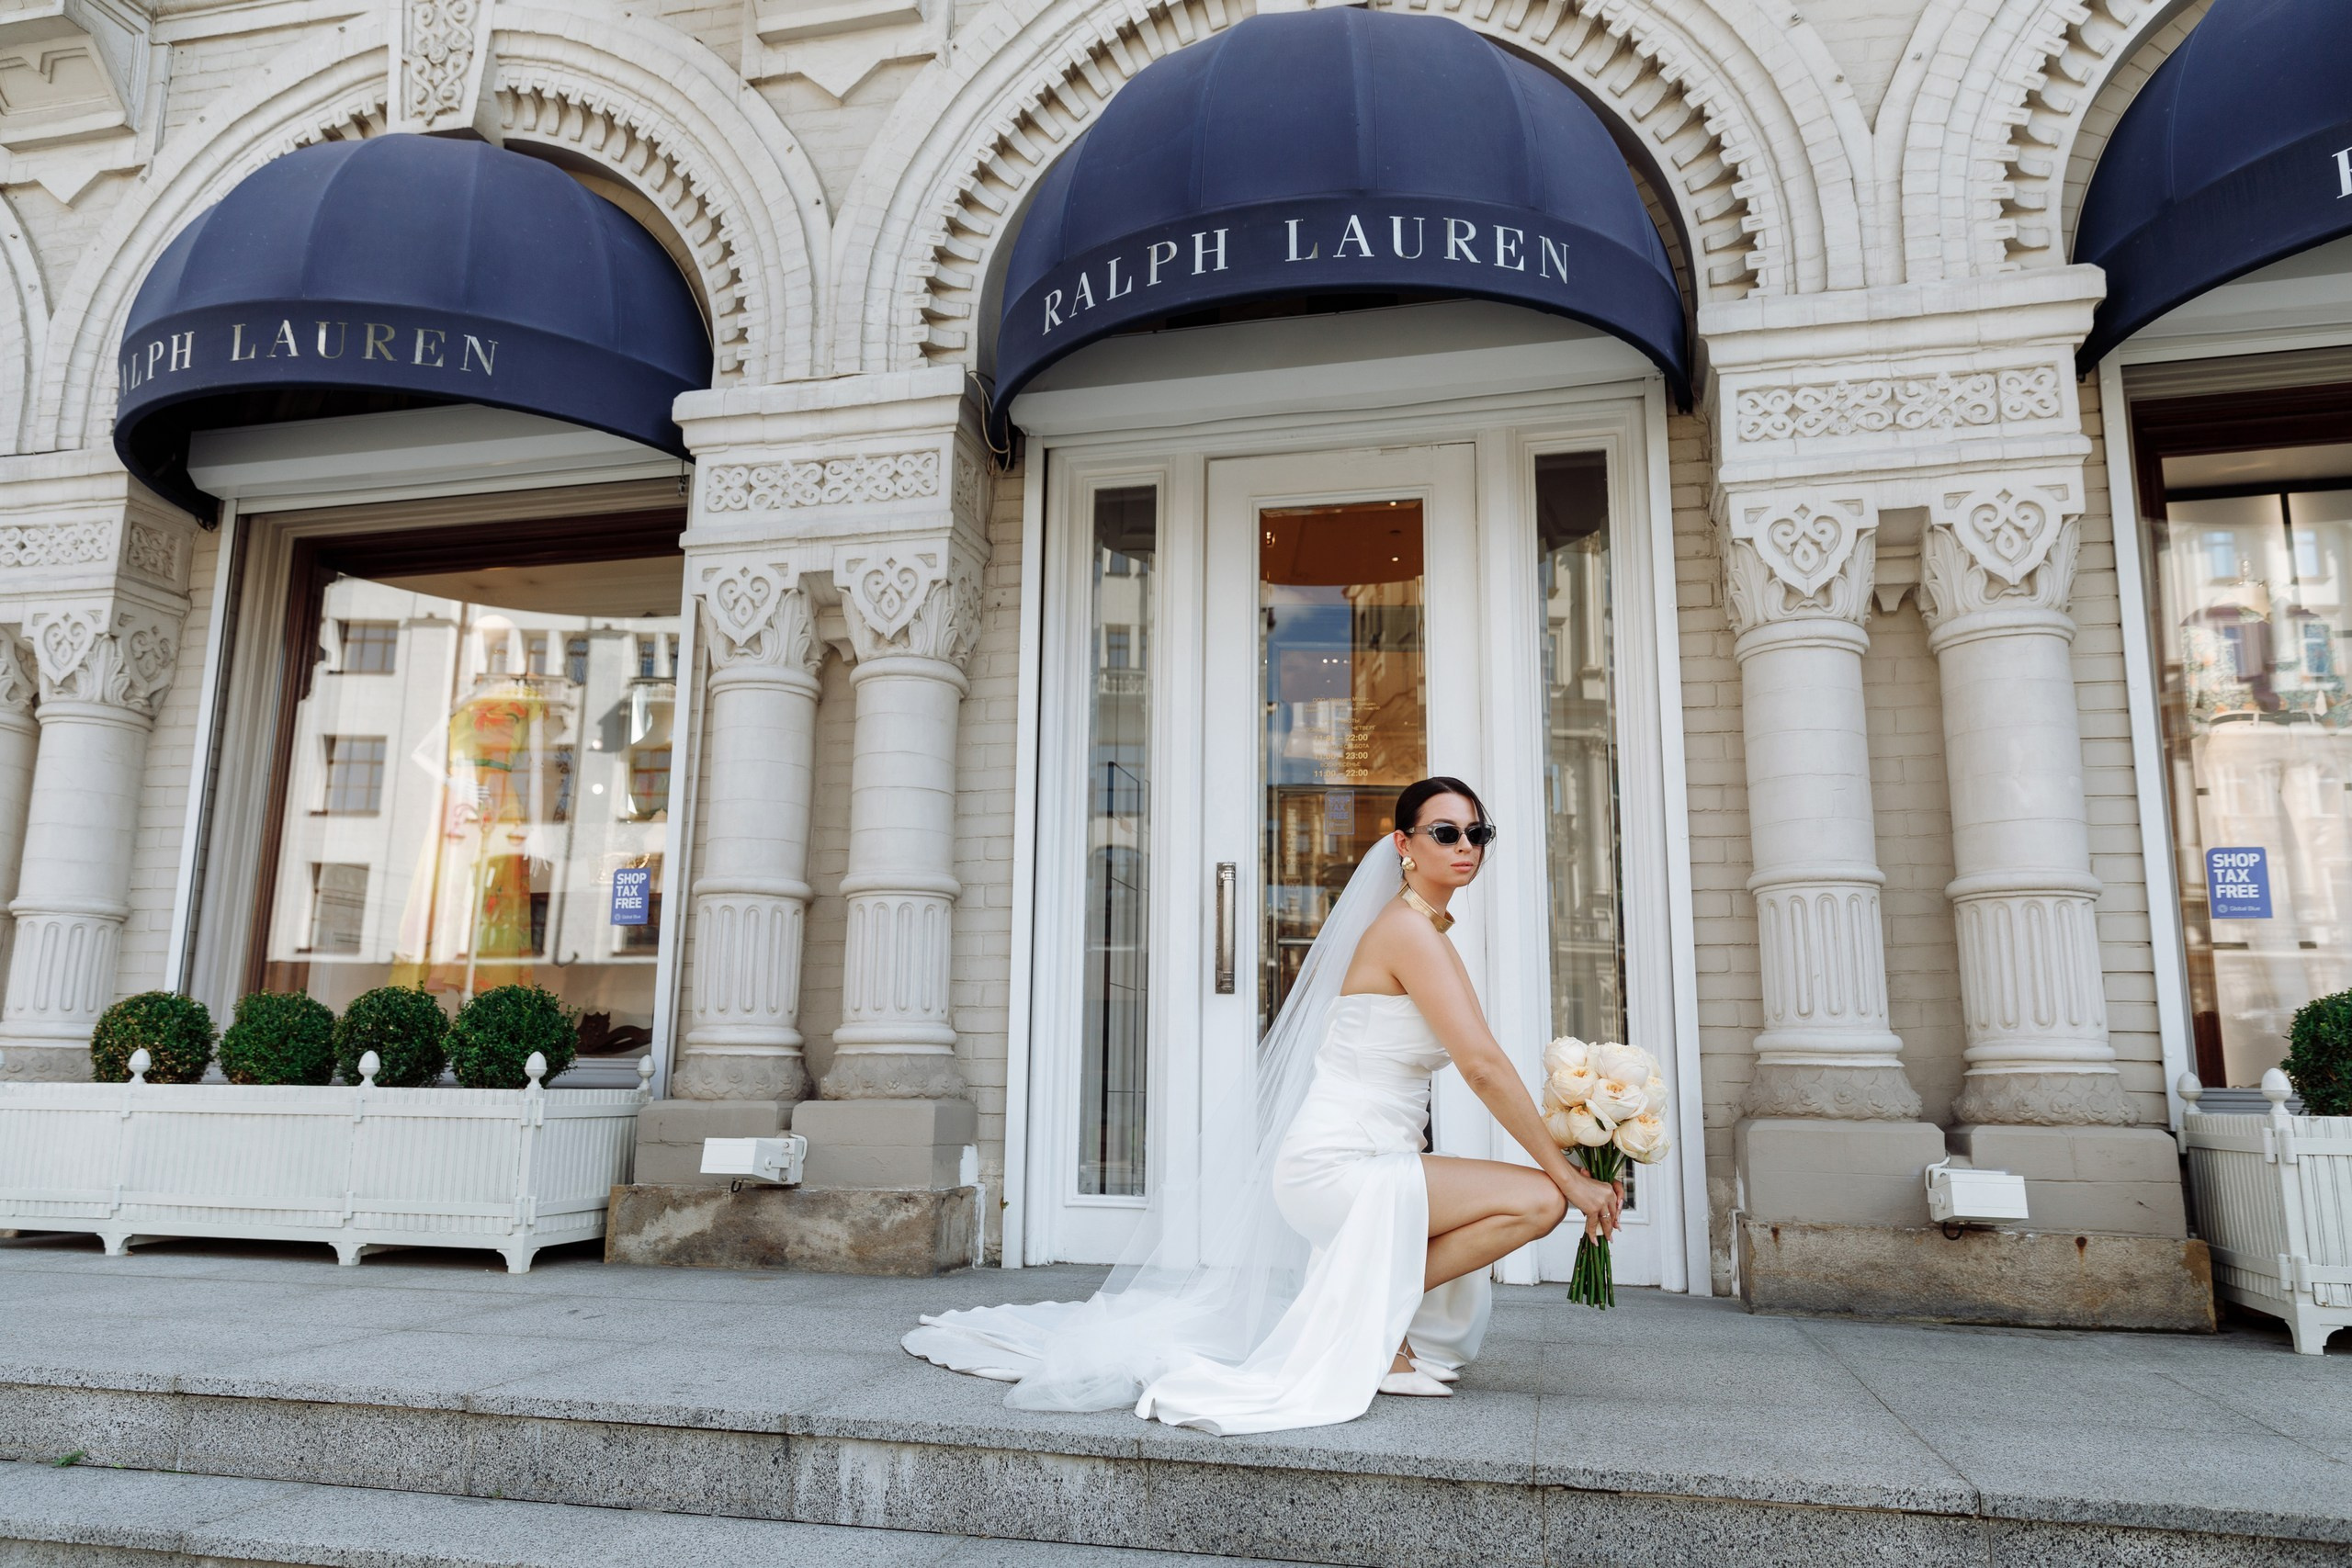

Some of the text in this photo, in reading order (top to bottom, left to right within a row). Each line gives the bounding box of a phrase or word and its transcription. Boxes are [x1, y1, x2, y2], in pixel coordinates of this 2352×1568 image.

[1042, 214, 1569, 336] RALPH LAUREN
[230, 319, 500, 377] LAUREN
[1345, 751, 1368, 760] 23:00
[1314, 770, 1336, 778] 11:00
[1345, 769, 1368, 777] 22:00
[2211, 852, 2260, 868] SHOP
[616, 873, 647, 885] SHOP
[2213, 869, 2251, 883] TAX
[616, 886, 639, 897] TAX
[2215, 884, 2260, 898] FREE
[615, 897, 642, 909] FREE
